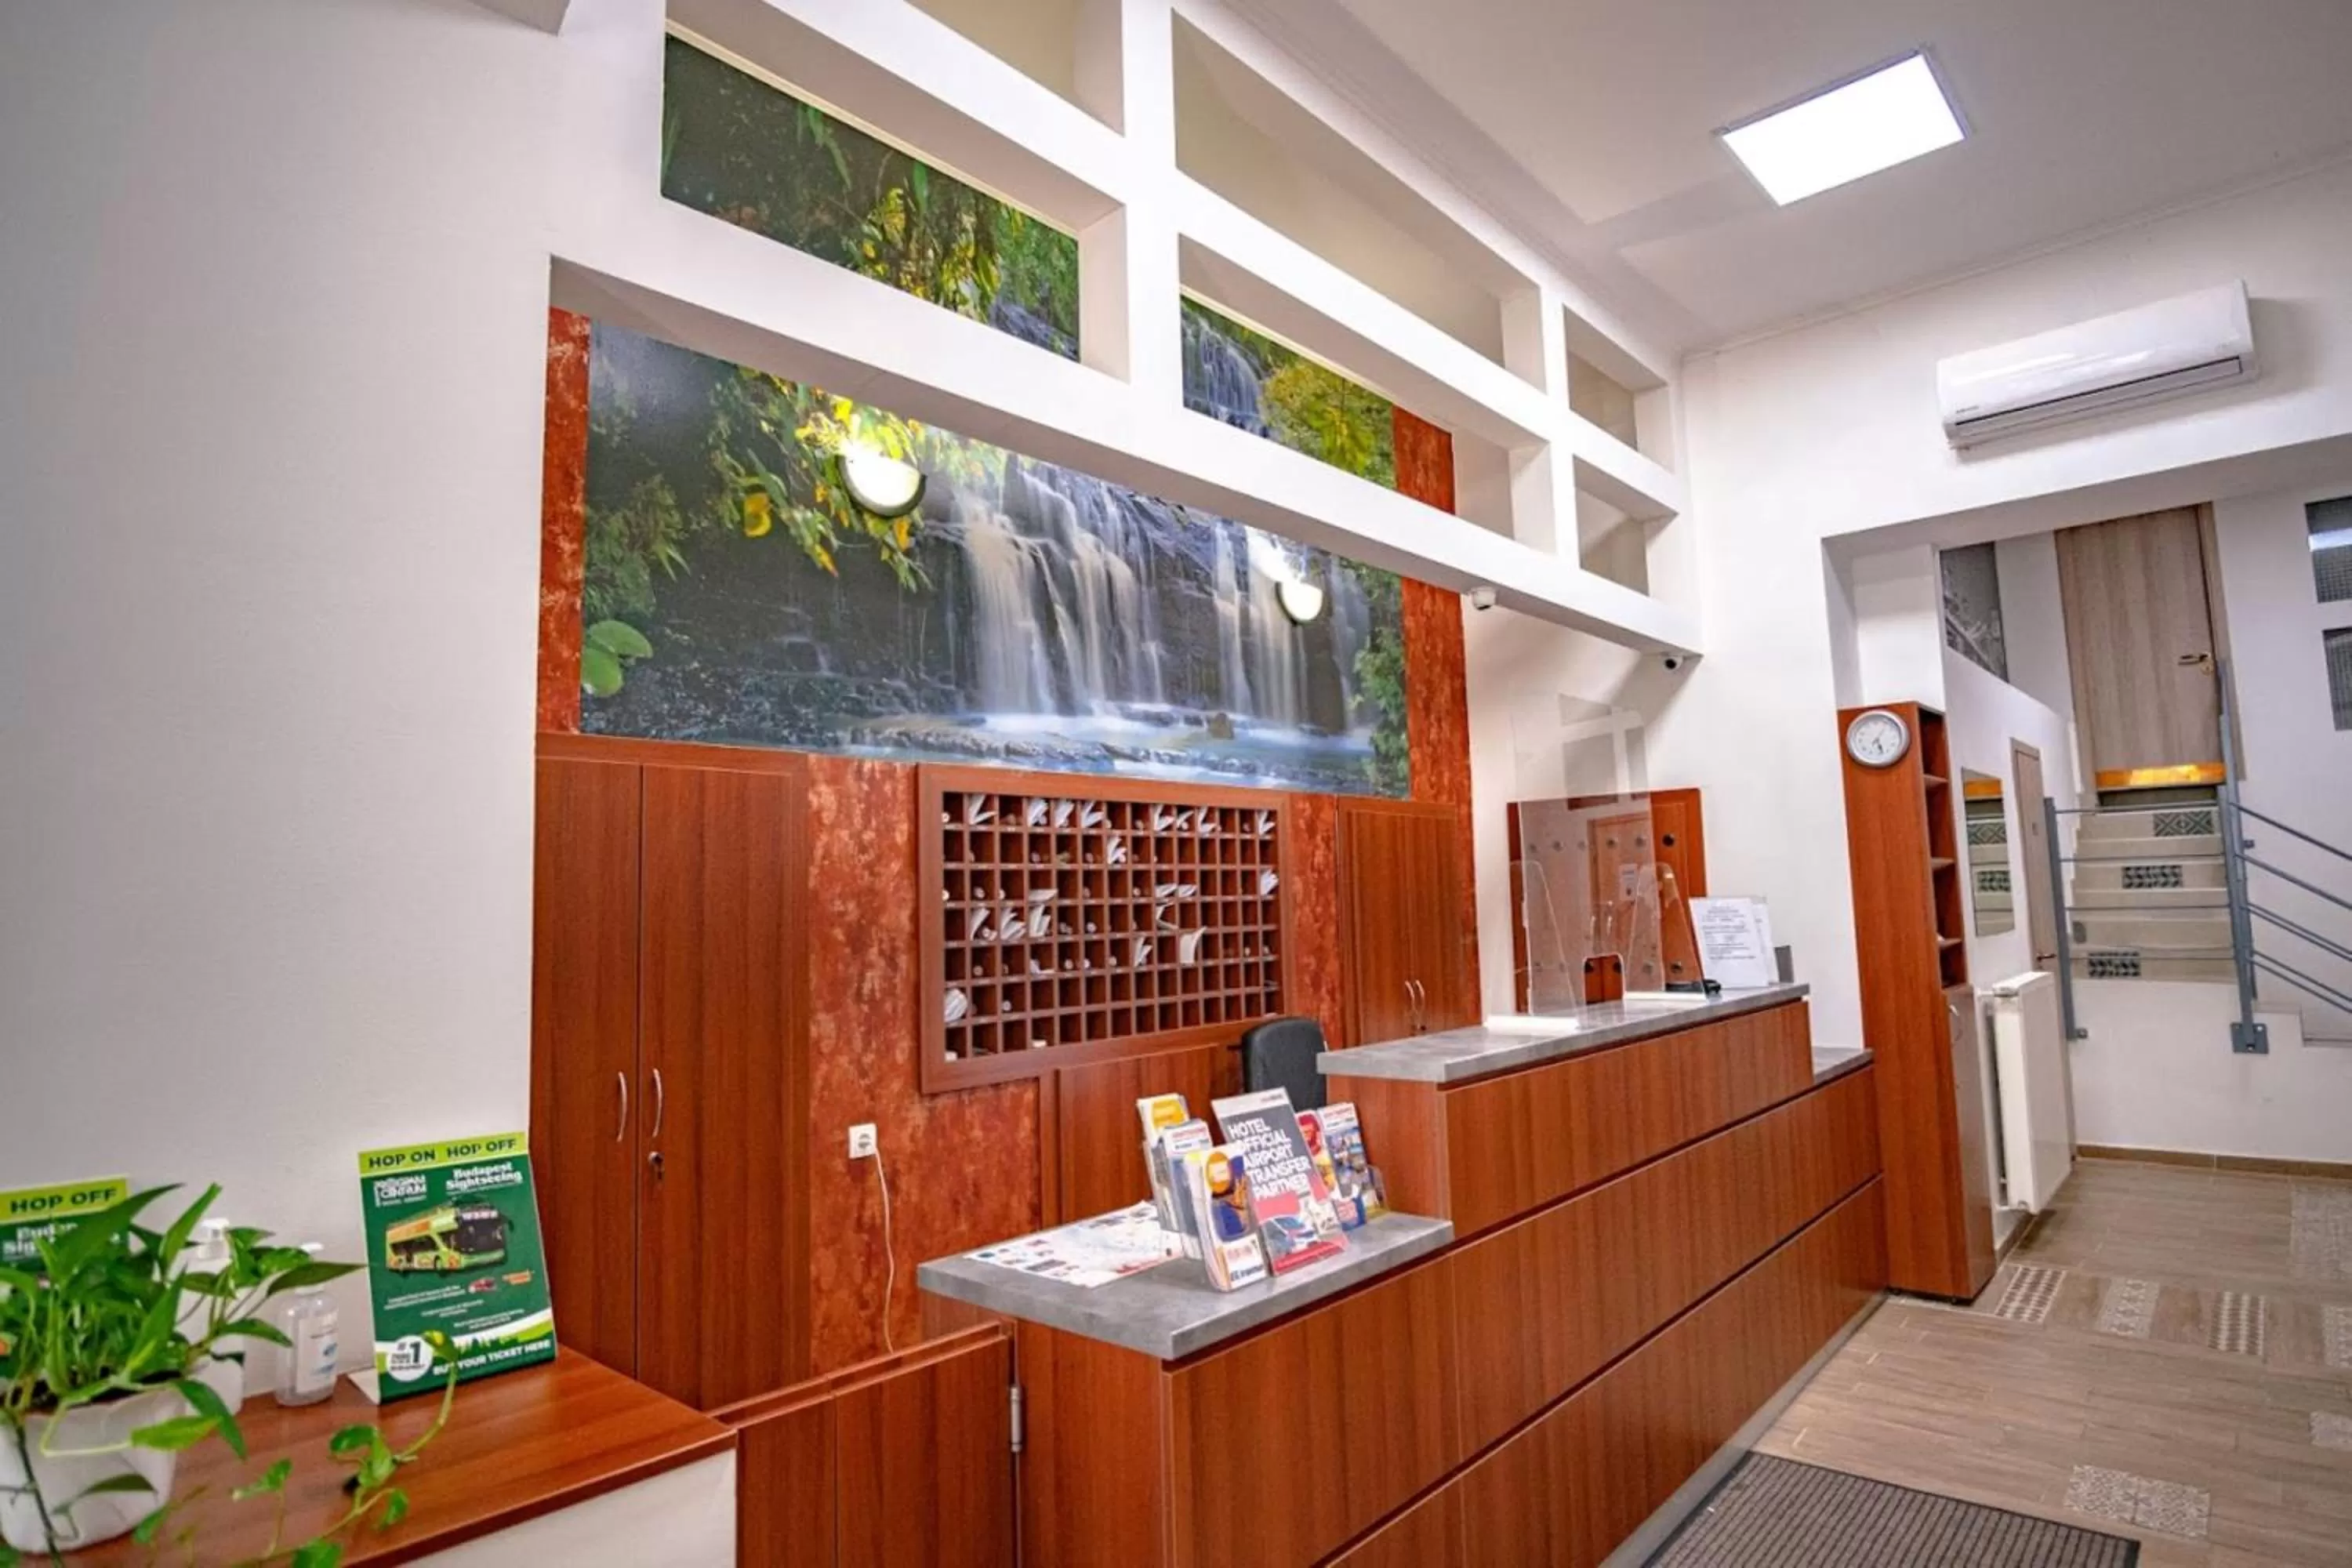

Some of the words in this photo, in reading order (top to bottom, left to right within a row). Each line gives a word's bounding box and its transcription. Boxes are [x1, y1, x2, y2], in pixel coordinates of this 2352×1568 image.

[1228, 1117, 1271, 1139] HOTEL
[369, 1153, 406, 1167] HOP
[411, 1150, 435, 1163] ON
[446, 1142, 481, 1157] HOP
[485, 1138, 516, 1152] OFF
[1243, 1144, 1294, 1169] AIRPORT
[445, 1172, 523, 1191] Sightseeing
[452, 1161, 514, 1180] Budapest
[1246, 1156, 1311, 1185] TRANSFER
[10, 1194, 63, 1213] HOP
[71, 1187, 117, 1206] OFF
[1253, 1173, 1309, 1203] PARTNER
[458, 1355, 487, 1370] YOUR
[488, 1346, 523, 1362] TICKET
[524, 1339, 552, 1353] HERE
